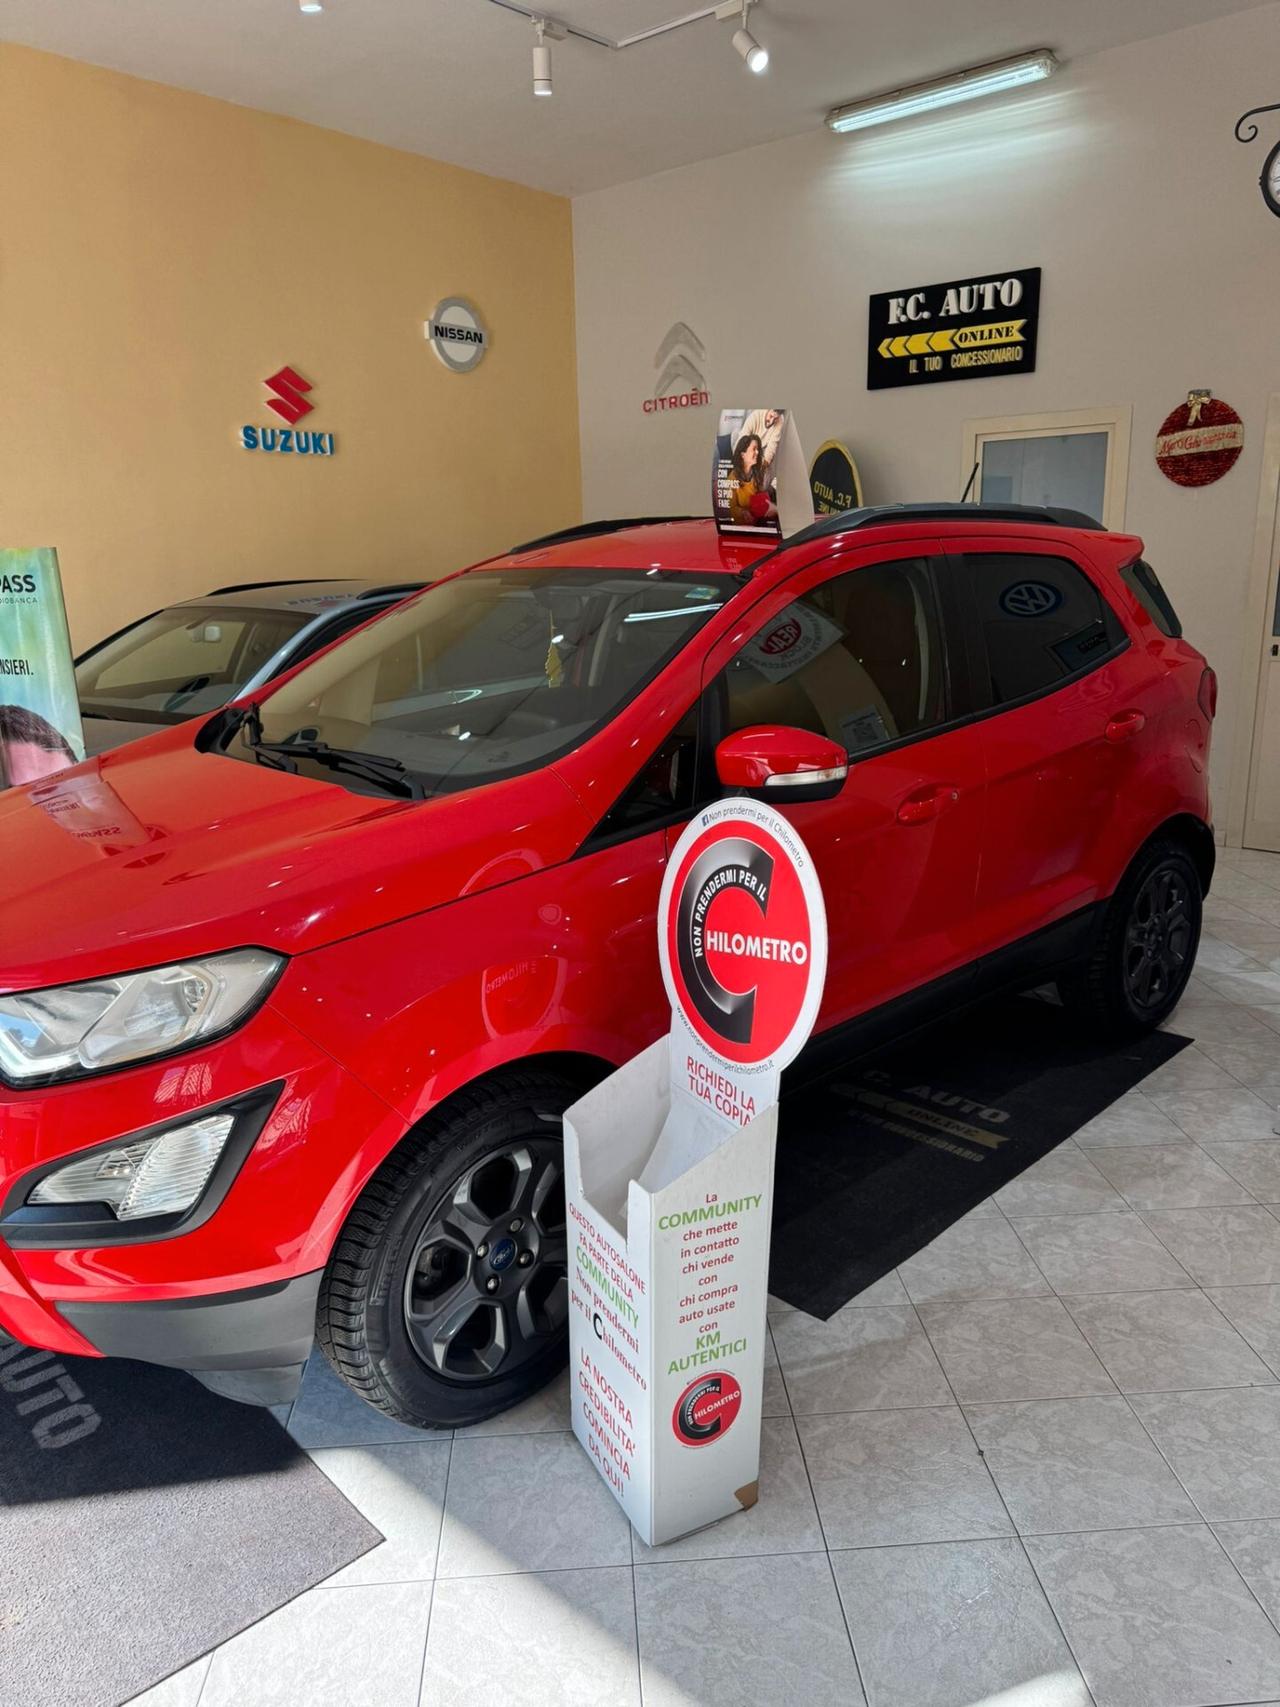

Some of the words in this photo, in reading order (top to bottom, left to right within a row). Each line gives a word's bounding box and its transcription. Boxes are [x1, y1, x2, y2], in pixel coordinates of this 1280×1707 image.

[888, 293, 932, 325] F.C.
[939, 278, 1023, 317] AUTO
[434, 325, 483, 344] NISSAN
[958, 325, 1014, 344] ONLINE
[909, 359, 919, 373] IL
[924, 356, 943, 372] TUO
[951, 346, 1023, 369] CONCESSIONARIO
[241, 425, 335, 456] SUZUKI
[0, 574, 36, 593] ASS
[709, 809, 722, 821] Non
[723, 807, 756, 819] prendermi
[758, 813, 770, 824] per
[773, 822, 804, 868] Chilometro
[695, 869, 736, 923] PRENDERMI
[739, 871, 756, 890] PER
[757, 884, 768, 901] IL
[693, 926, 703, 957] NON
[687, 1056, 737, 1098] RICHIEDI
[741, 1091, 756, 1116] LA
[688, 1075, 712, 1104] TUA
[715, 1094, 751, 1127] COPIA
[901, 1085, 1011, 1123] AUTO
[908, 1108, 979, 1137] ONLINE
[658, 1194, 762, 1231] COMMUNITY
[705, 1193, 718, 1204] La
[683, 1230, 703, 1242] che
[705, 1221, 738, 1236] mette
[569, 1202, 595, 1238] QUESTO
[596, 1233, 646, 1295] AUTOSALONE
[681, 1248, 691, 1259] in
[694, 1236, 740, 1255] contatto
[579, 1232, 588, 1250] FA
[589, 1243, 610, 1274] PARTE
[611, 1268, 633, 1302] DELLA
[682, 1261, 698, 1274] chi
[701, 1254, 735, 1269] vende
[576, 1246, 638, 1328] COMMUNITY
[679, 1294, 696, 1307] chi
[698, 1284, 738, 1302] compra
[698, 1274, 718, 1286] con
[576, 1266, 592, 1295] Non
[594, 1293, 639, 1353] prendermi
[679, 1310, 704, 1324] auto
[707, 1300, 736, 1316] usate
[571, 1290, 583, 1311] per
[585, 1304, 591, 1321] il
[593, 1312, 646, 1390] Chilometro
[696, 1330, 721, 1350] KM
[699, 1321, 718, 1333] con
[668, 1338, 747, 1375] AUTENTICI
[581, 1346, 591, 1374] LA
[593, 1365, 633, 1429] NOSTRA
[579, 1371, 636, 1457] CREDIBILITA'
[583, 1402, 631, 1480] COMINCIA
[589, 1434, 601, 1463] DA
[603, 1457, 625, 1497] QUI!
